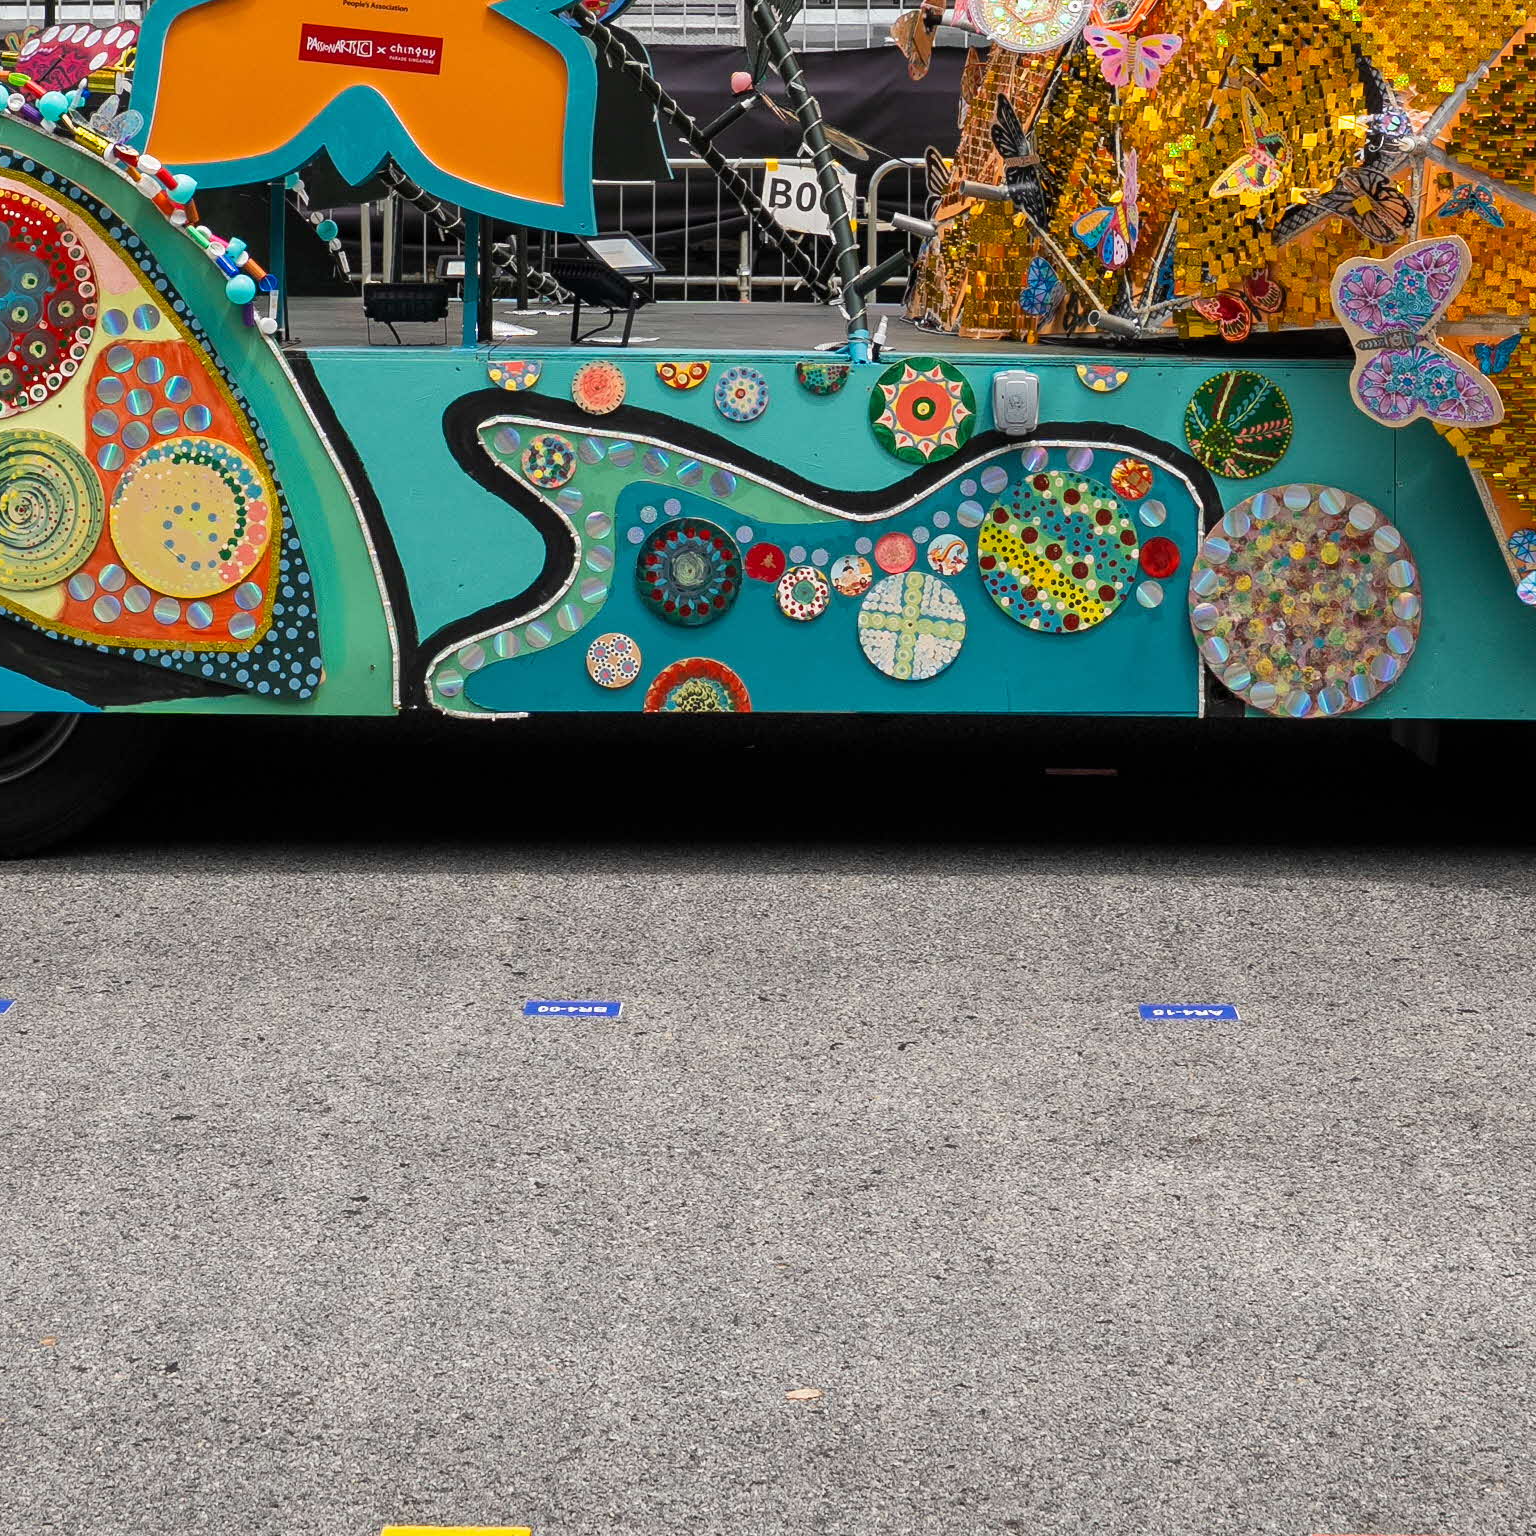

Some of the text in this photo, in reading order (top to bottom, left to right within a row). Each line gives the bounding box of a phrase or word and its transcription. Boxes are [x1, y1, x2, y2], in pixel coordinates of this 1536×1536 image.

[342, 0, 409, 13] People's Association
[389, 43, 437, 59] chingay
[768, 177, 827, 214] B0
[537, 1005, 608, 1013] BR4-00
